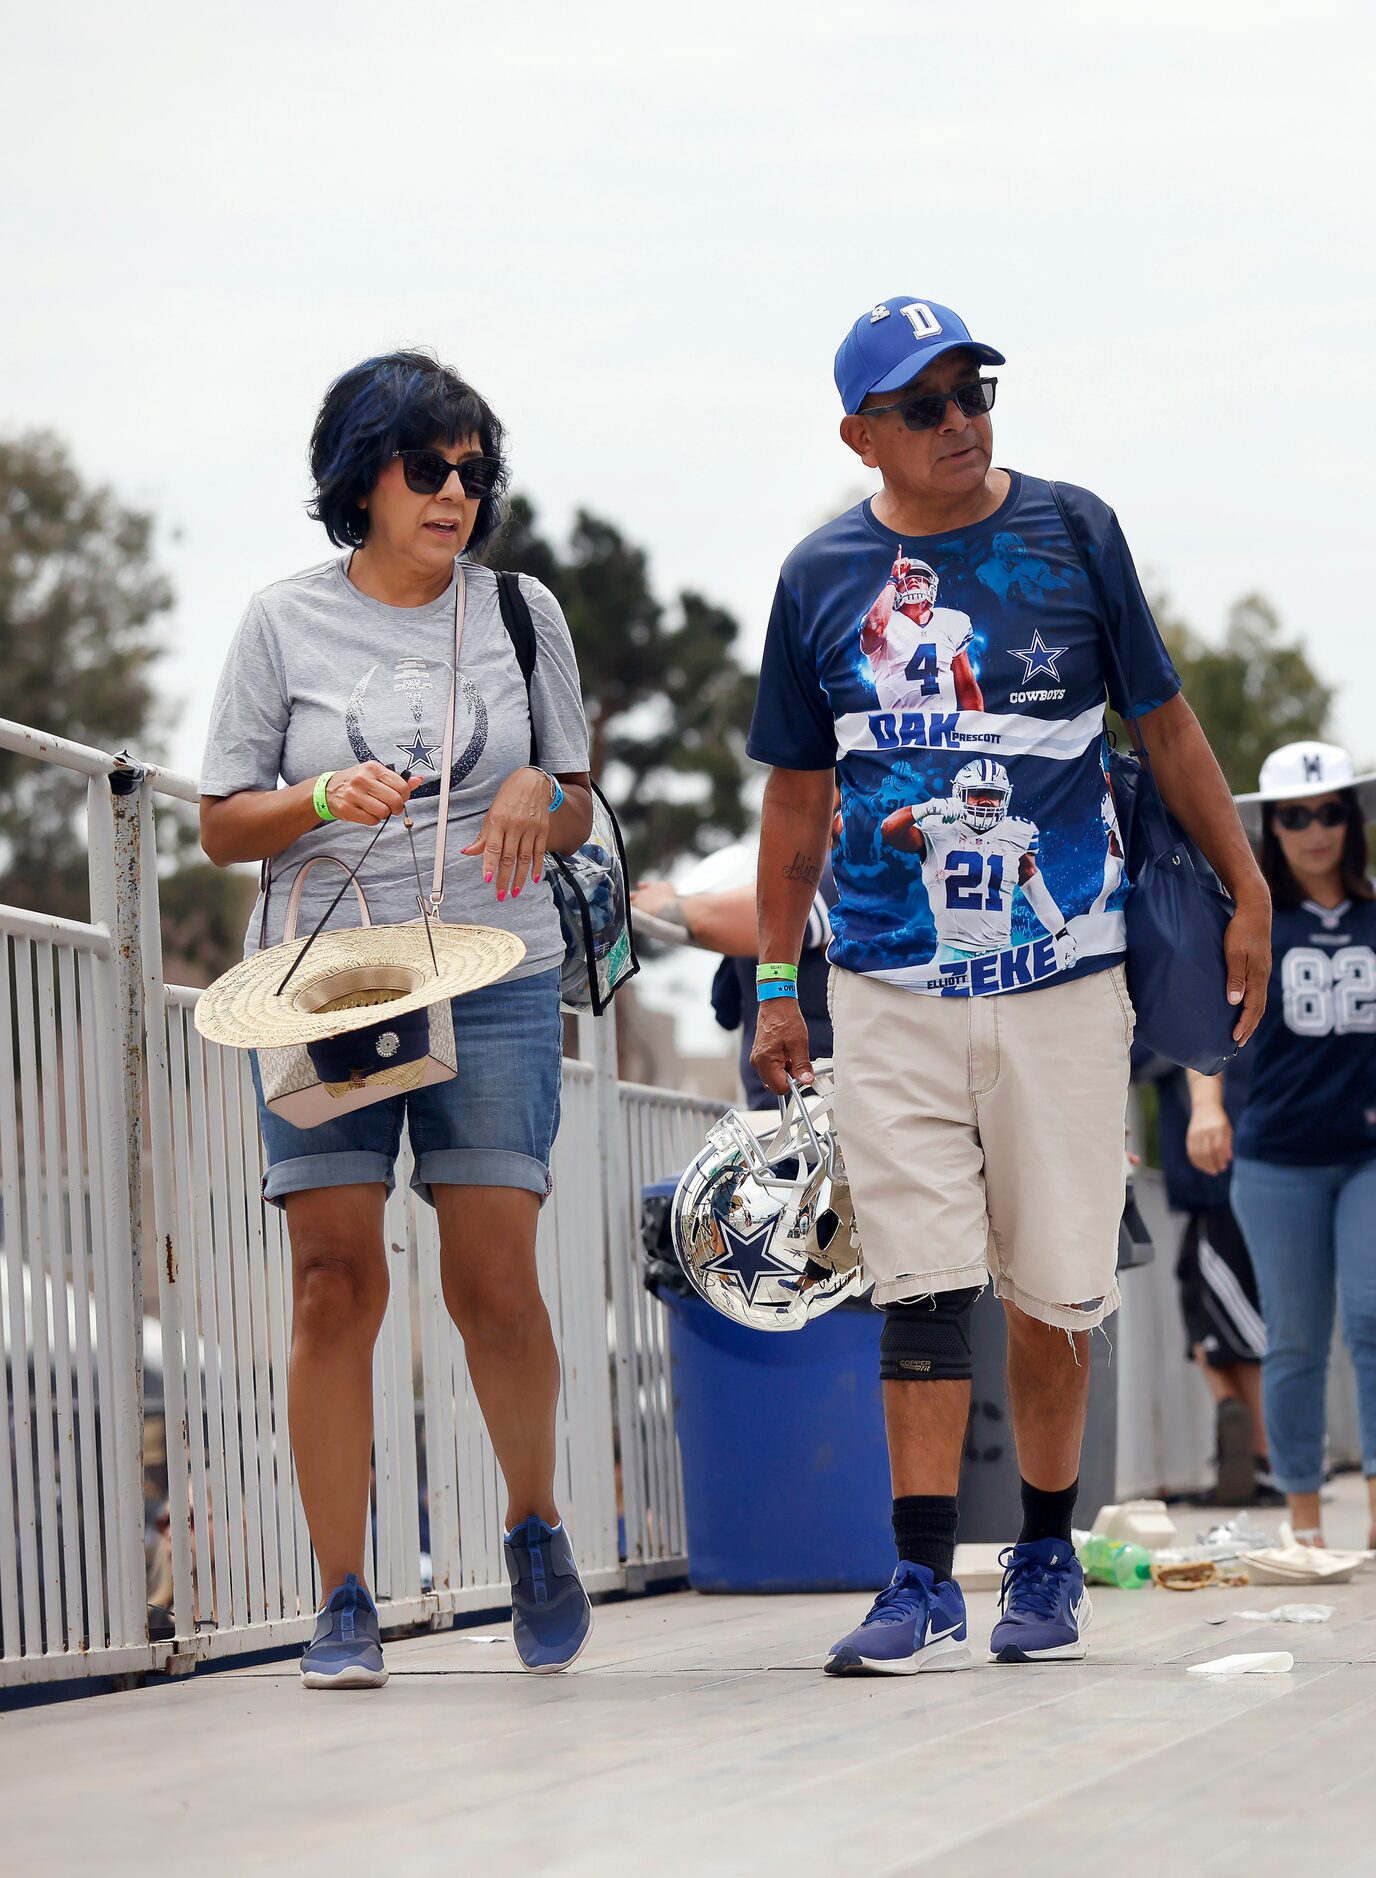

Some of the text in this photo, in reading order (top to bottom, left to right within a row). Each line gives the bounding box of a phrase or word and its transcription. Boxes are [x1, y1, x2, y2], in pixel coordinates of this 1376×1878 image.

[899, 302, 943, 341] D
[904, 642, 941, 697] 4
[1009, 688, 1066, 704] COWBOYS
[868, 711, 1002, 749] DAK PRESCOTT
[944, 850, 1004, 912] 21
[926, 934, 1058, 997] ELLIOTT ZEKE
